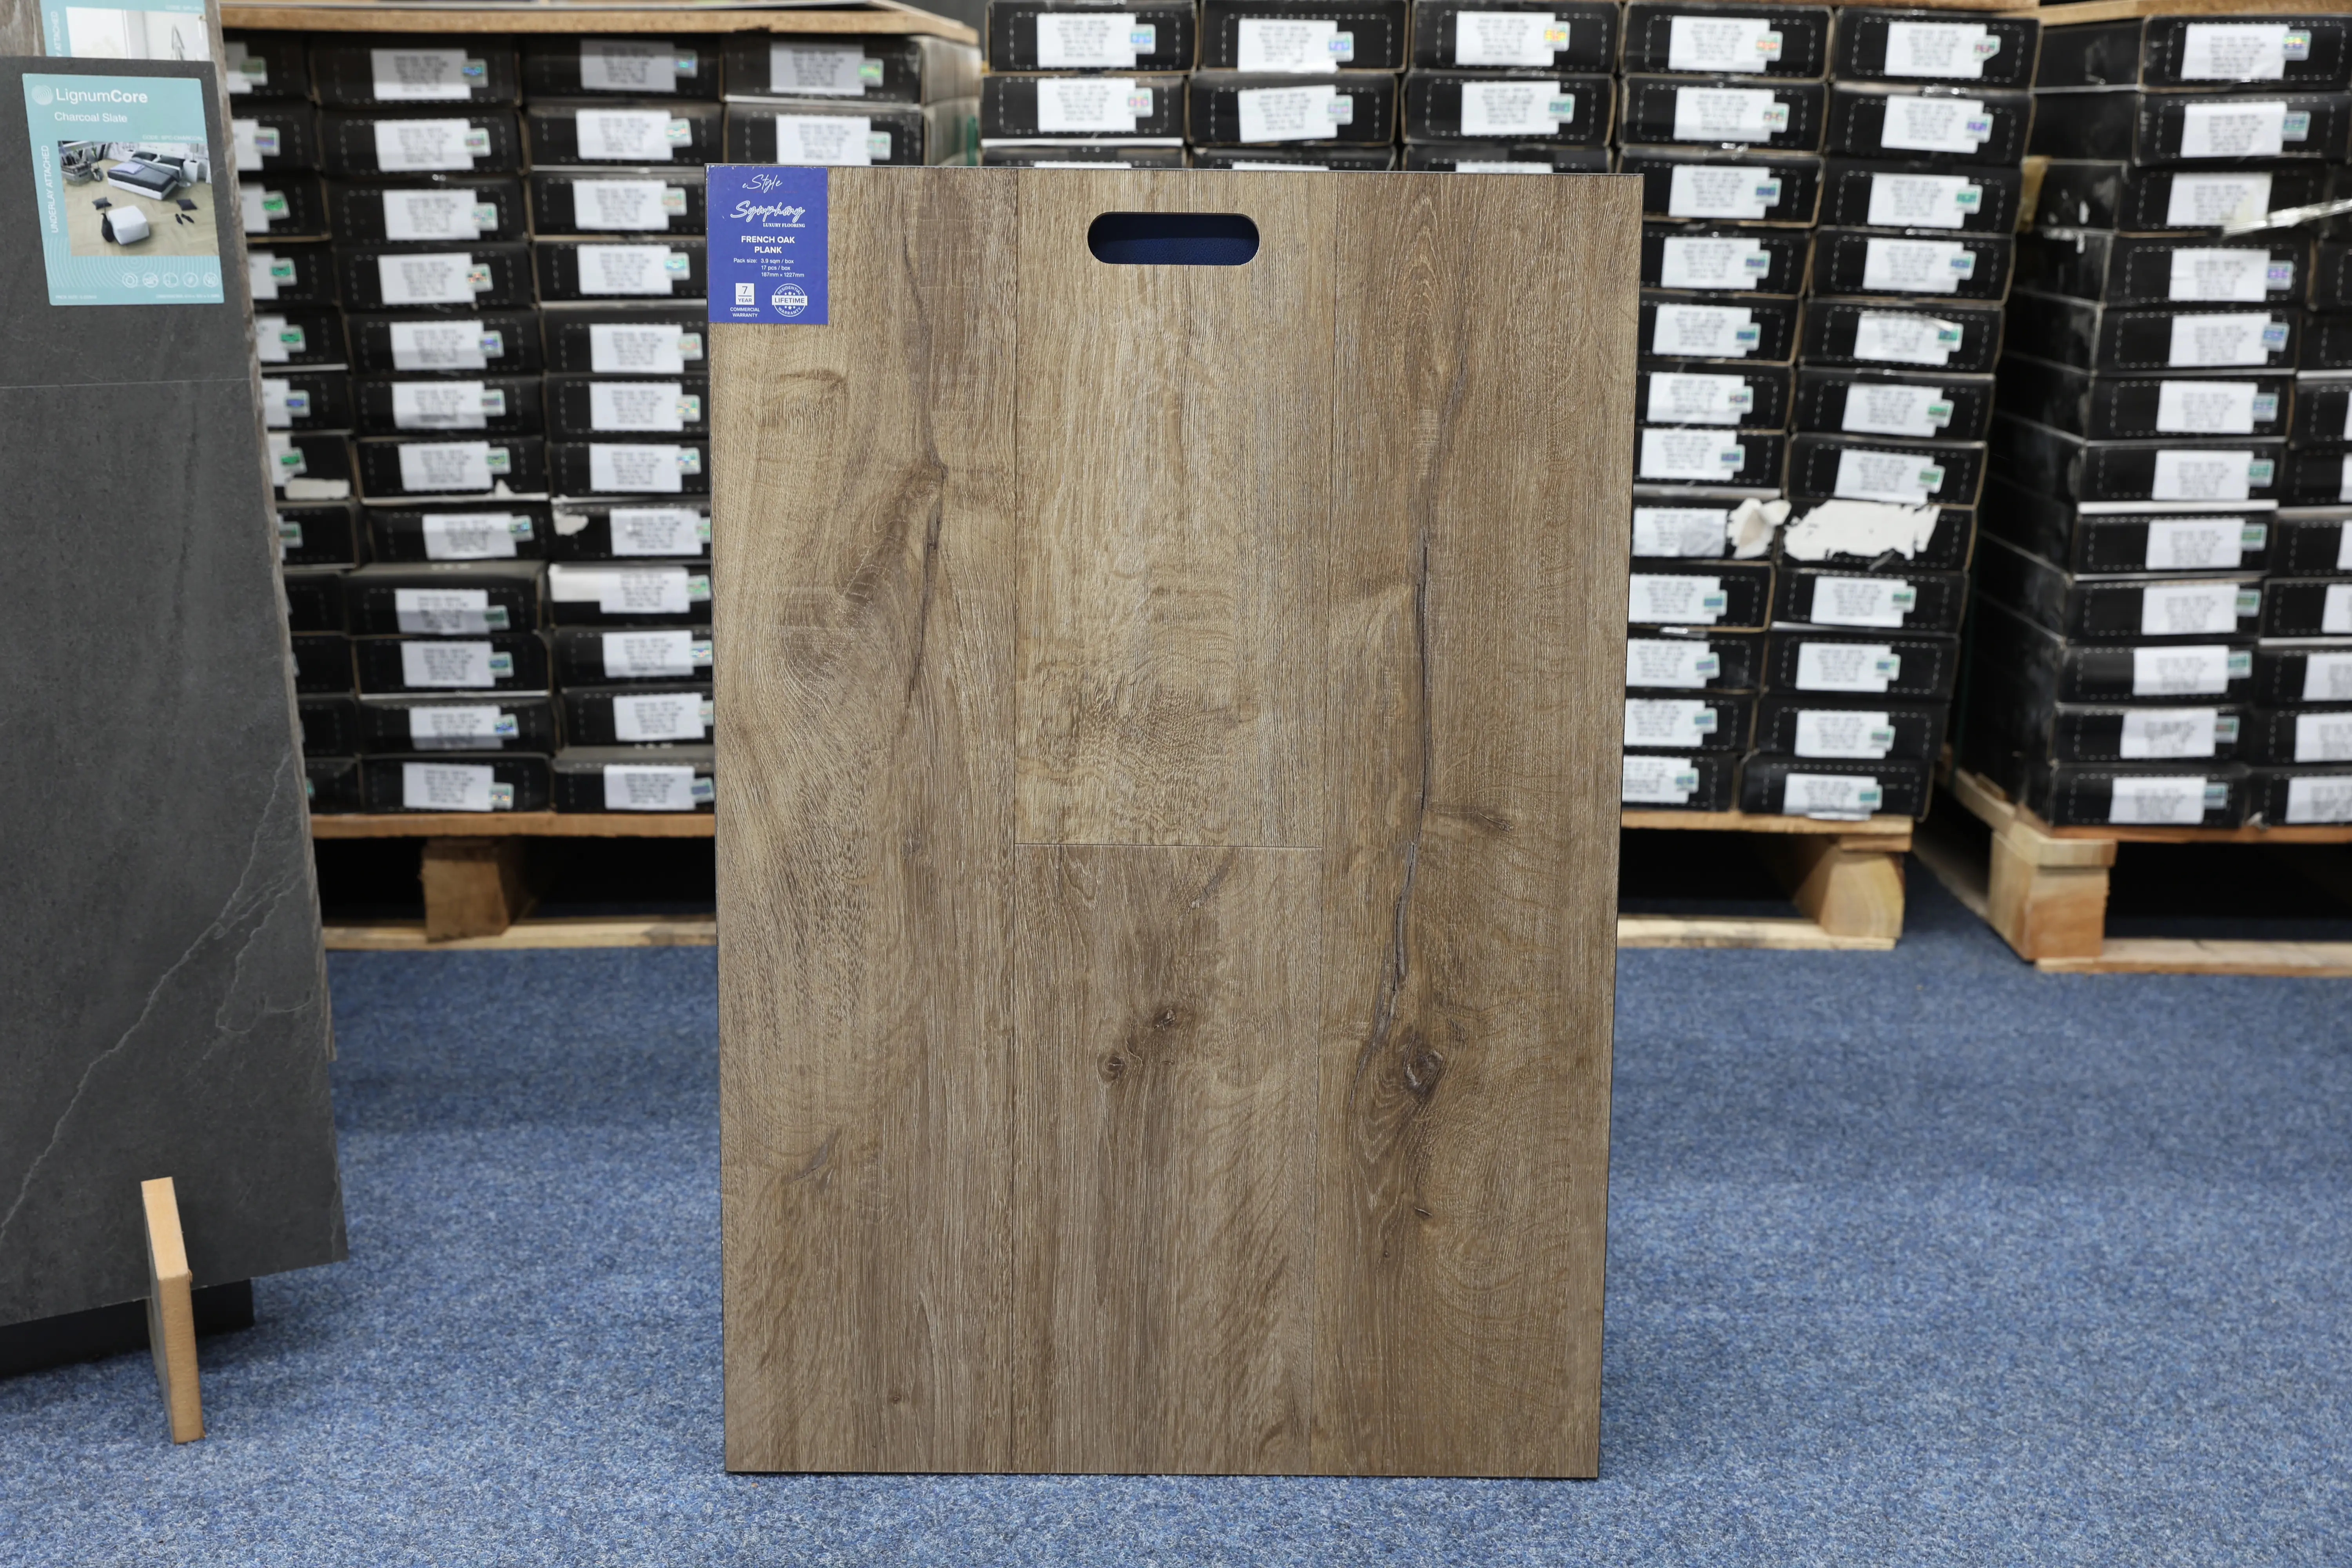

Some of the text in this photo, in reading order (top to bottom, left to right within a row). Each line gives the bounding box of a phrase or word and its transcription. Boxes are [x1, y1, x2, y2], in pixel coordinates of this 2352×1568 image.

[56, 88, 147, 104] LignumCore
[54, 112, 127, 122] Charcoal Slate
[41, 145, 58, 233] UNDERLAY ATTACHED
[742, 174, 782, 193] eStyle
[730, 201, 805, 223] Symphony
[777, 286, 801, 295] RESIDENTIAL
[779, 307, 801, 315] WARRANTY
